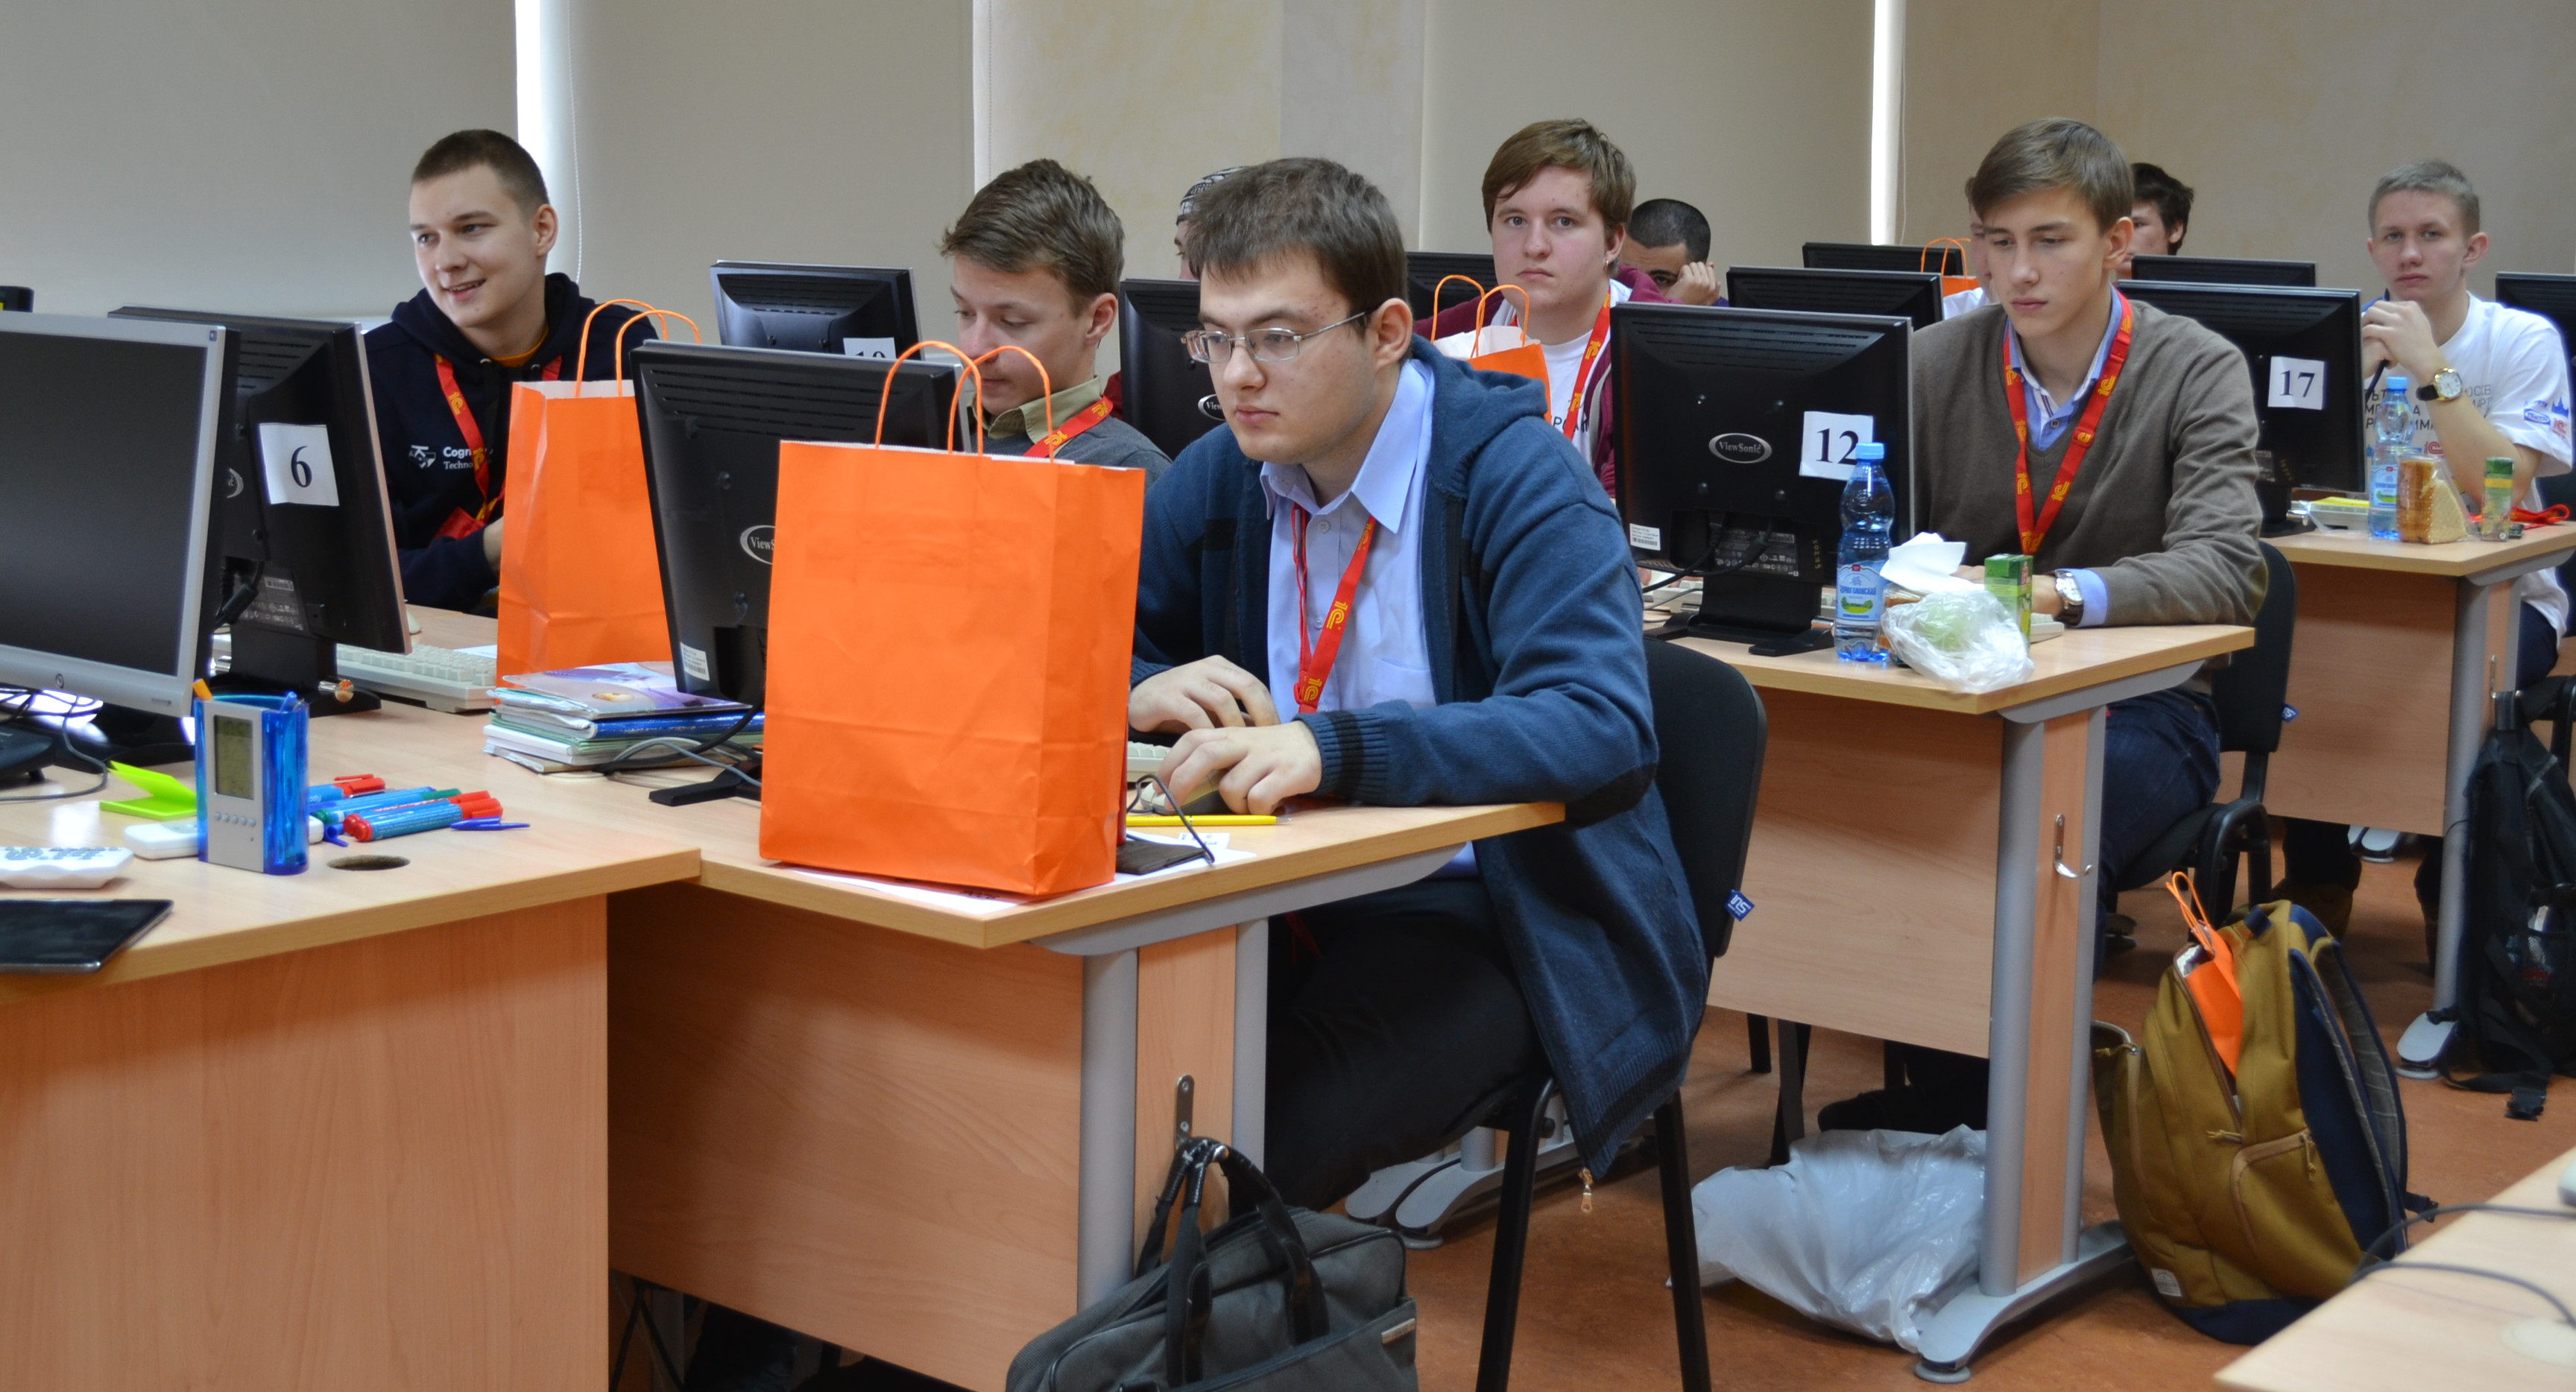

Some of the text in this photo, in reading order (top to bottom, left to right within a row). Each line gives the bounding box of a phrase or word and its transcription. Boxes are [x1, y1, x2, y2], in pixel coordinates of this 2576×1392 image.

[2279, 370, 2315, 397] 17
[1719, 441, 1762, 454] ViewSonic
[1816, 428, 1859, 466] 12
[291, 445, 312, 488] 6
[443, 461, 473, 469] Techno
[750, 536, 775, 551] ViewS
